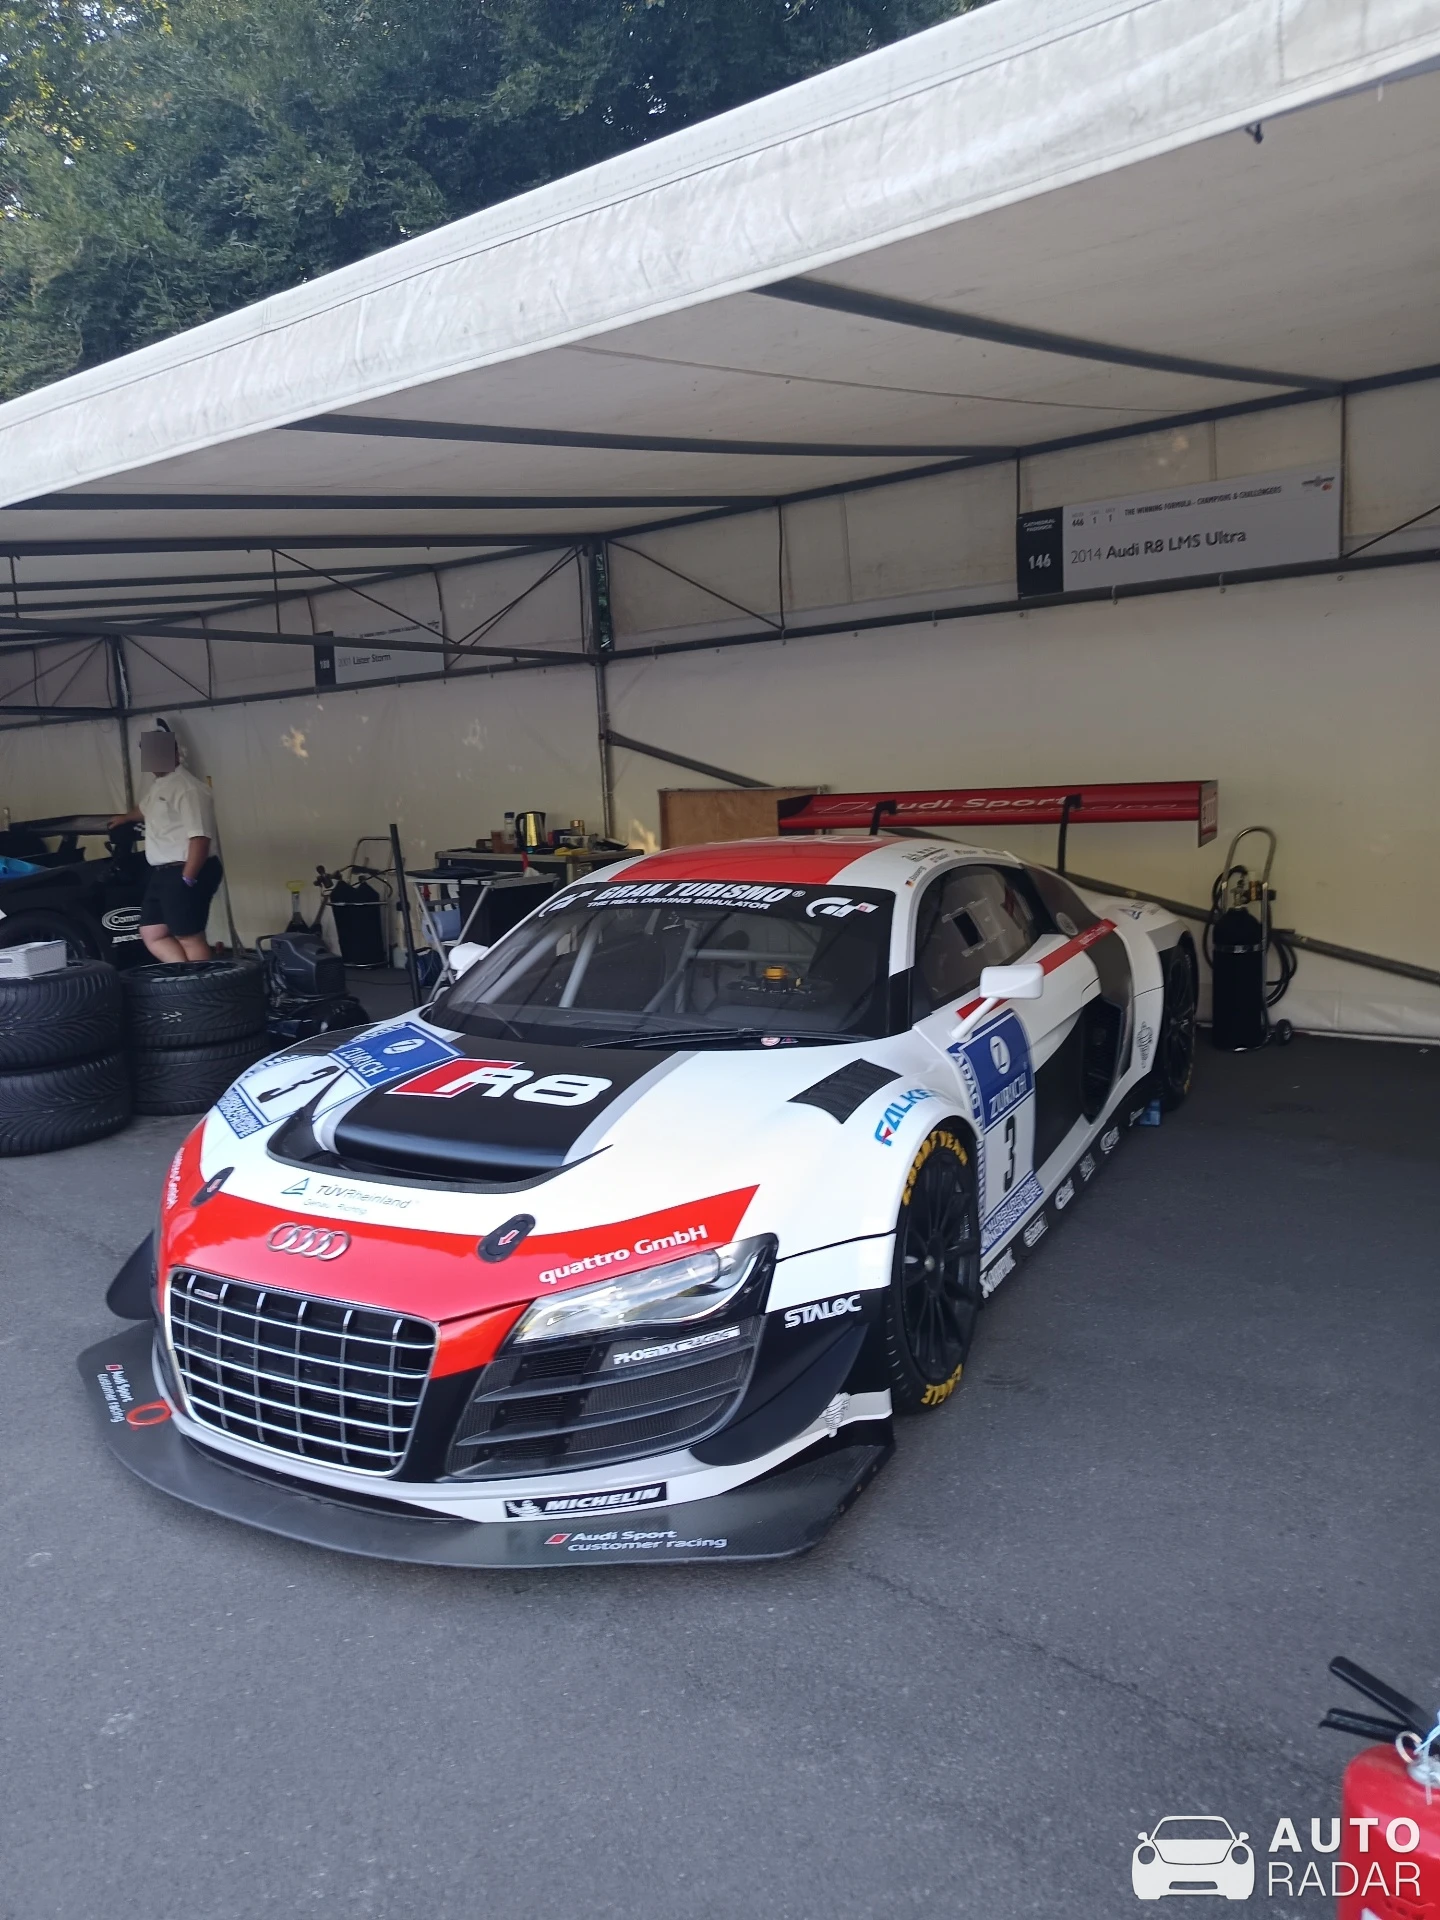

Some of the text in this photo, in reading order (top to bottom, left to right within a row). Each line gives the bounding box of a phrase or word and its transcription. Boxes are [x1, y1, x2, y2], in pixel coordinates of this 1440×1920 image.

[1125, 508, 1135, 516] THE
[1137, 504, 1163, 514] WINNING
[1164, 500, 1192, 510] FORMULA
[1197, 493, 1231, 506] CHAMPIONS
[1028, 553, 1051, 570] 146
[1071, 529, 1247, 564] 2014 Audi R8 LMS Ultra
[962, 796, 1068, 809] Sport
[593, 883, 673, 900] GRAN
[609, 898, 639, 906] REAL
[640, 897, 693, 905] DRIVING
[693, 898, 770, 910] SIMULATOR
[339, 1046, 388, 1079] ZURICH
[953, 1051, 980, 1108] ADAC
[257, 1066, 340, 1104] 3
[434, 1066, 613, 1106] R8
[989, 1077, 1028, 1119] ZURICH
[874, 1088, 934, 1147] FALKE
[1003, 1115, 1016, 1191] 3
[539, 1224, 708, 1285] quattro GmbH
[784, 1294, 862, 1329] STALOC
[97, 1373, 126, 1423] customer racing
[111, 1370, 134, 1403] Audi Sport
[544, 1487, 661, 1511] MICHELIN
[567, 1536, 728, 1552] customer racing
[571, 1529, 678, 1544] Audi Sport
